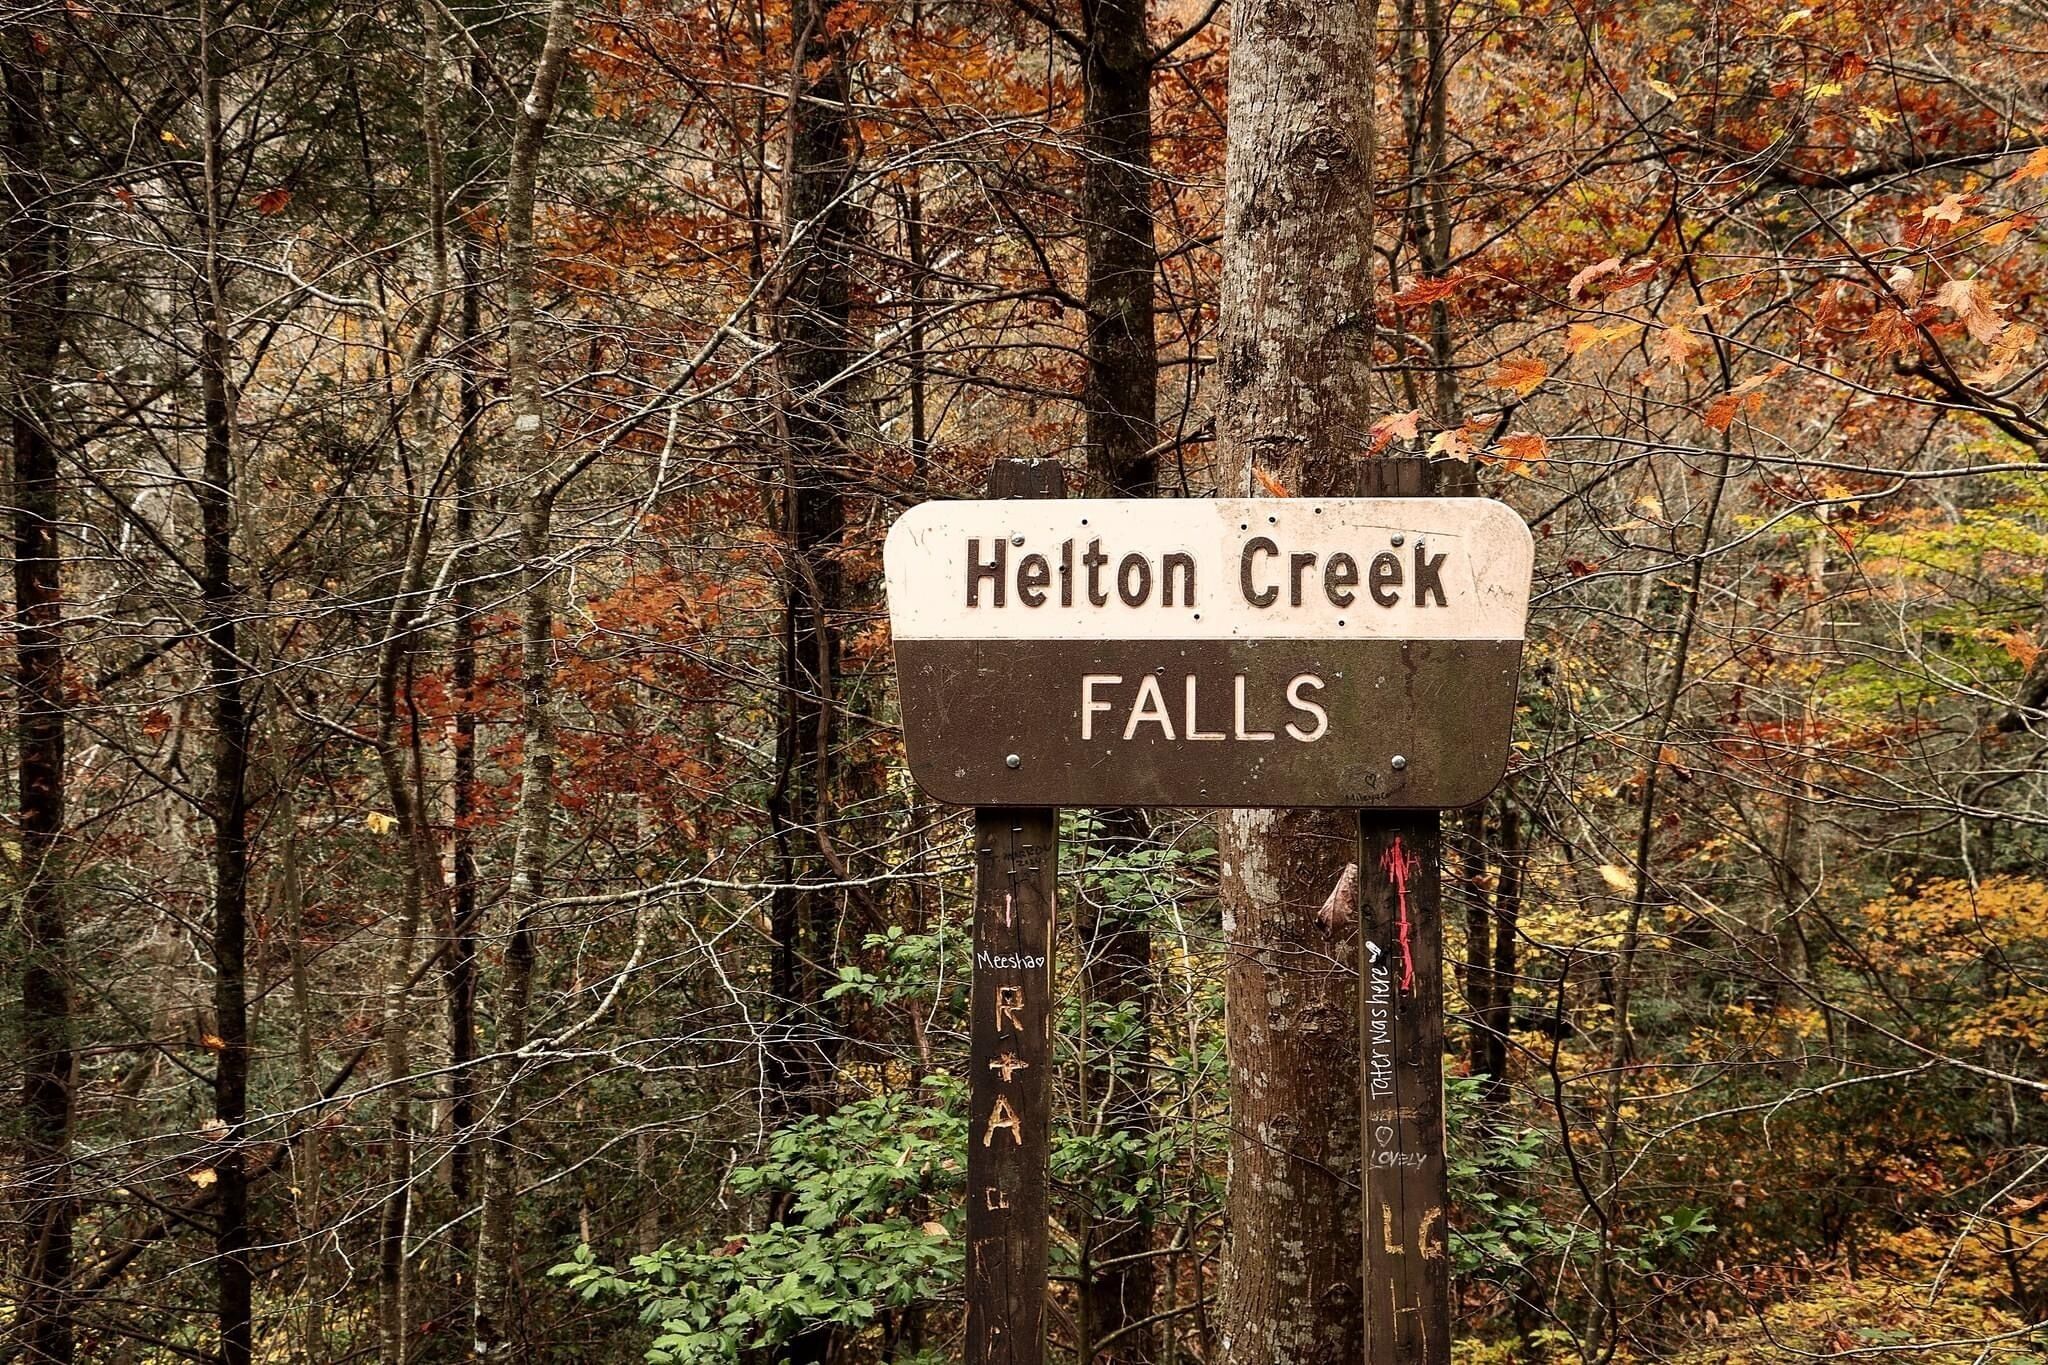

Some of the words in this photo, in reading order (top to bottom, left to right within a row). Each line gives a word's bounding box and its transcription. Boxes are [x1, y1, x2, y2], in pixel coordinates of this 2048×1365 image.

[965, 536, 1196, 608] Helton
[1239, 535, 1449, 608] Creek
[1080, 672, 1329, 743] FALLS
[977, 951, 1035, 970] Meesha
[1365, 965, 1391, 1004] here
[1370, 1007, 1391, 1044] was
